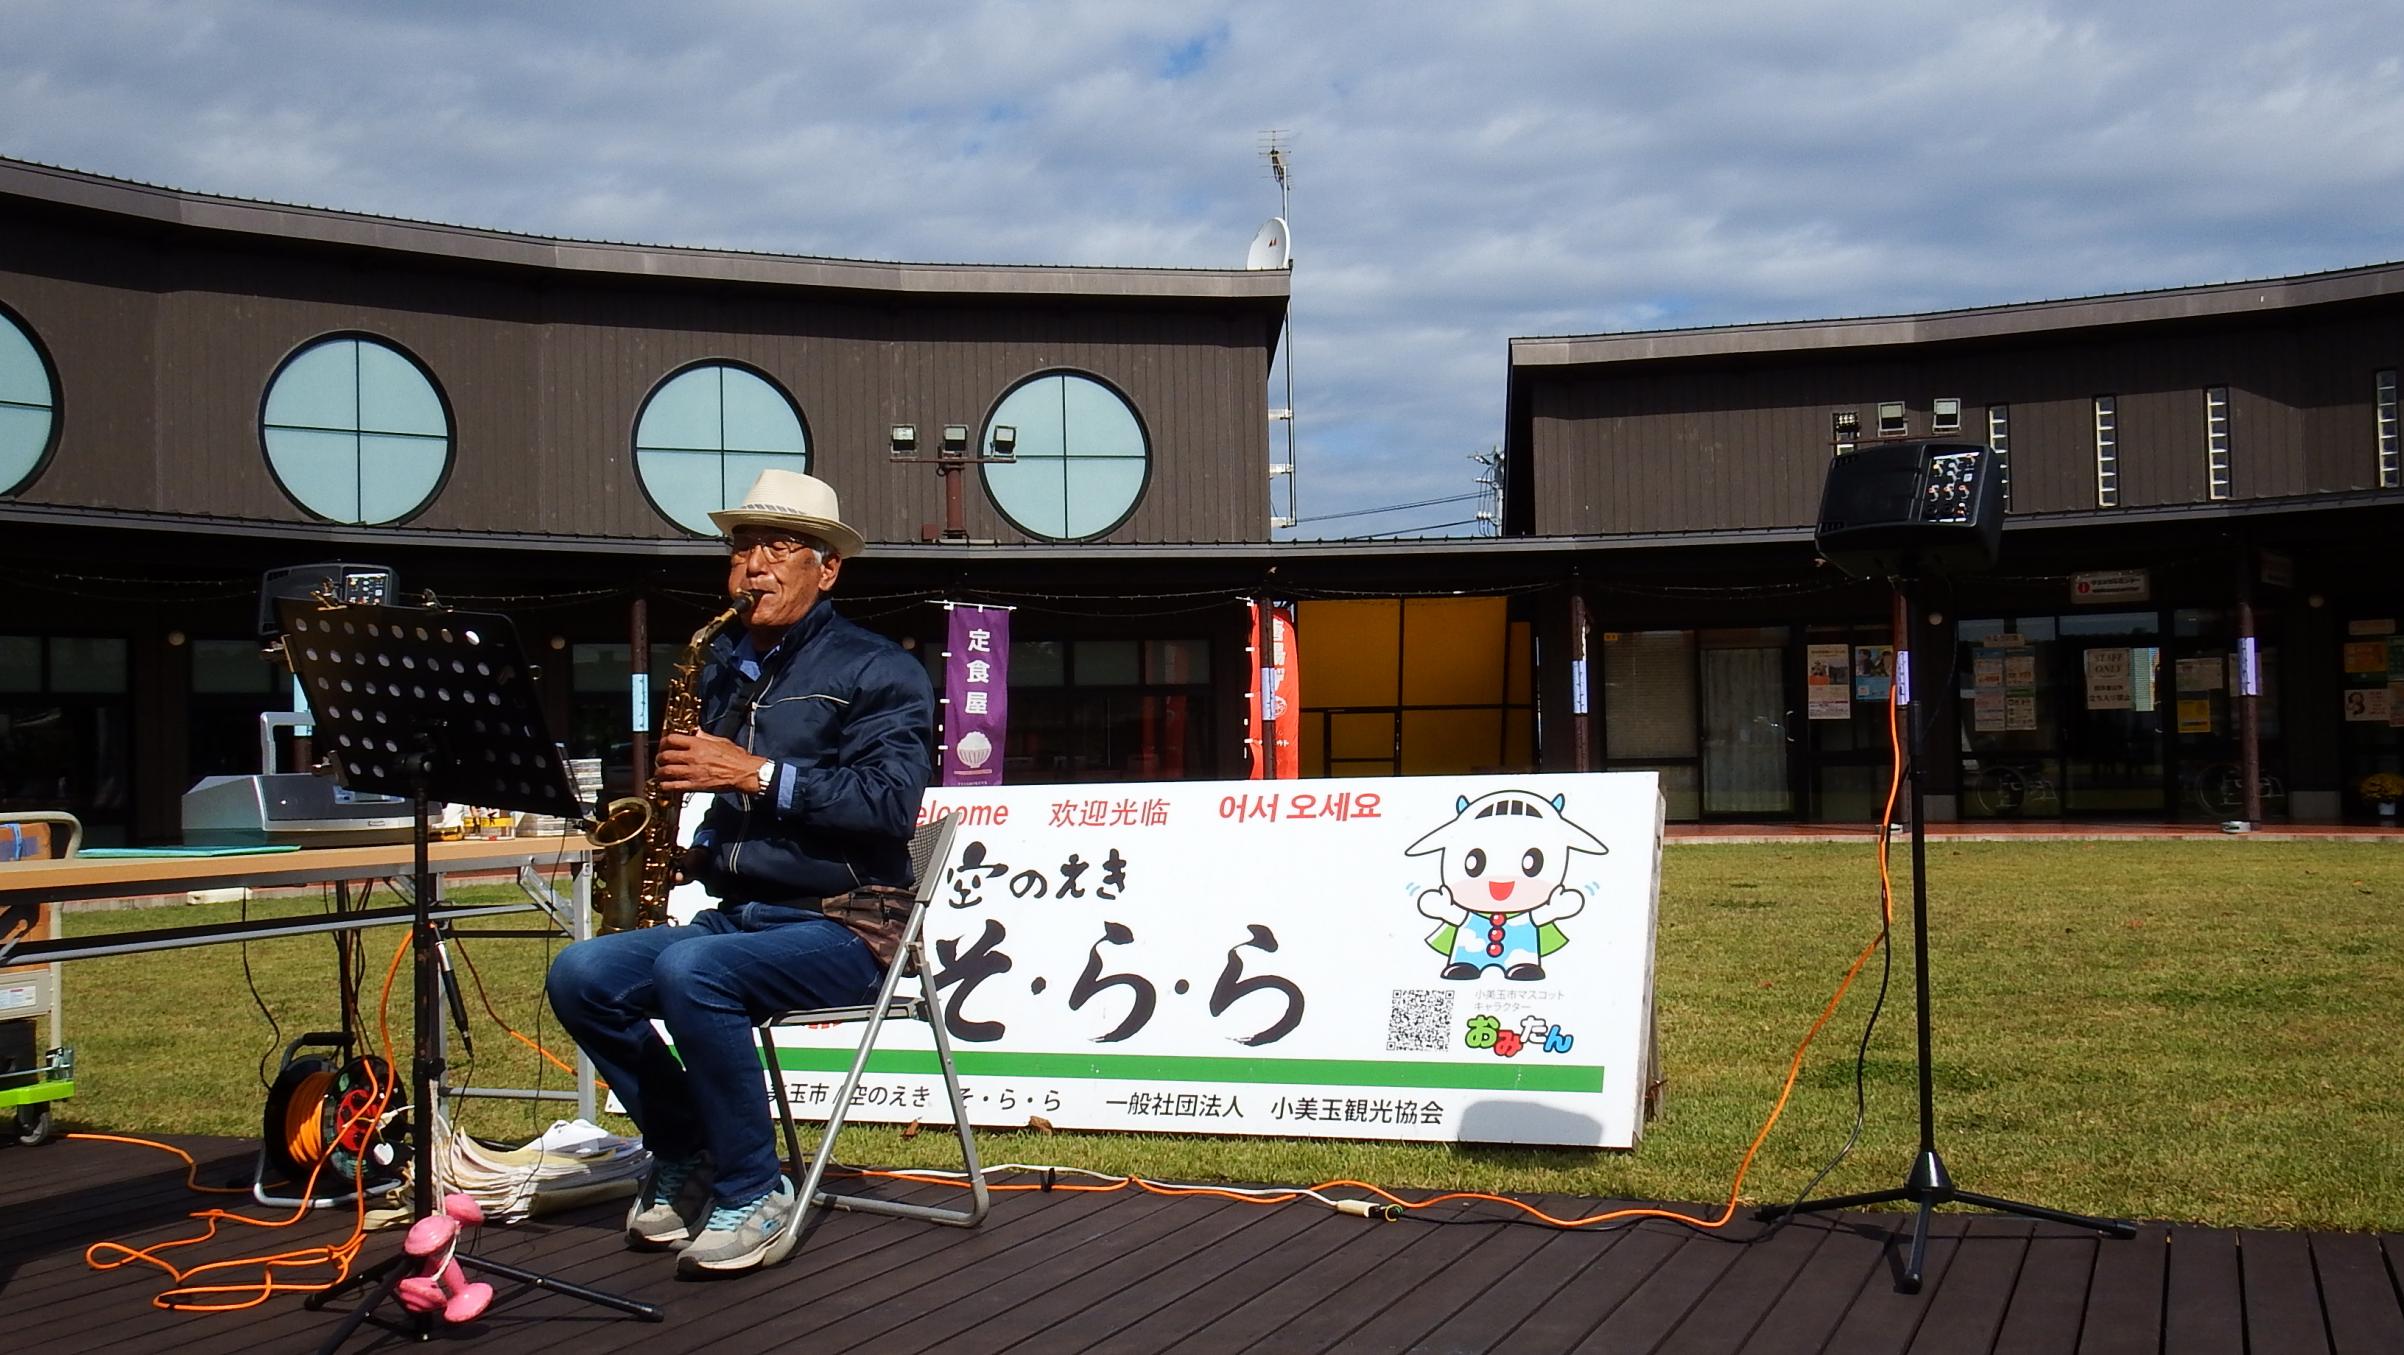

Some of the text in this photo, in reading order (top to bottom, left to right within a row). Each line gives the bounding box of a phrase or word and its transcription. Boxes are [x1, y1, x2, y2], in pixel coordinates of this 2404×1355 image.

[965, 628, 991, 715] 定食屋
[915, 799, 1009, 827] elcome
[1048, 798, 1171, 828] 欢迎光临
[1219, 792, 1382, 823] 어서 오세요
[947, 840, 1127, 910] 空のえき
[1474, 1002, 1531, 1012] キャラクター
[1475, 989, 1566, 1000] 小美玉市マスコット
[1465, 1014, 1574, 1058] おみたん
[1105, 1091, 1245, 1119] 一般社団法人
[1271, 1096, 1445, 1125] 小美玉観光協会
